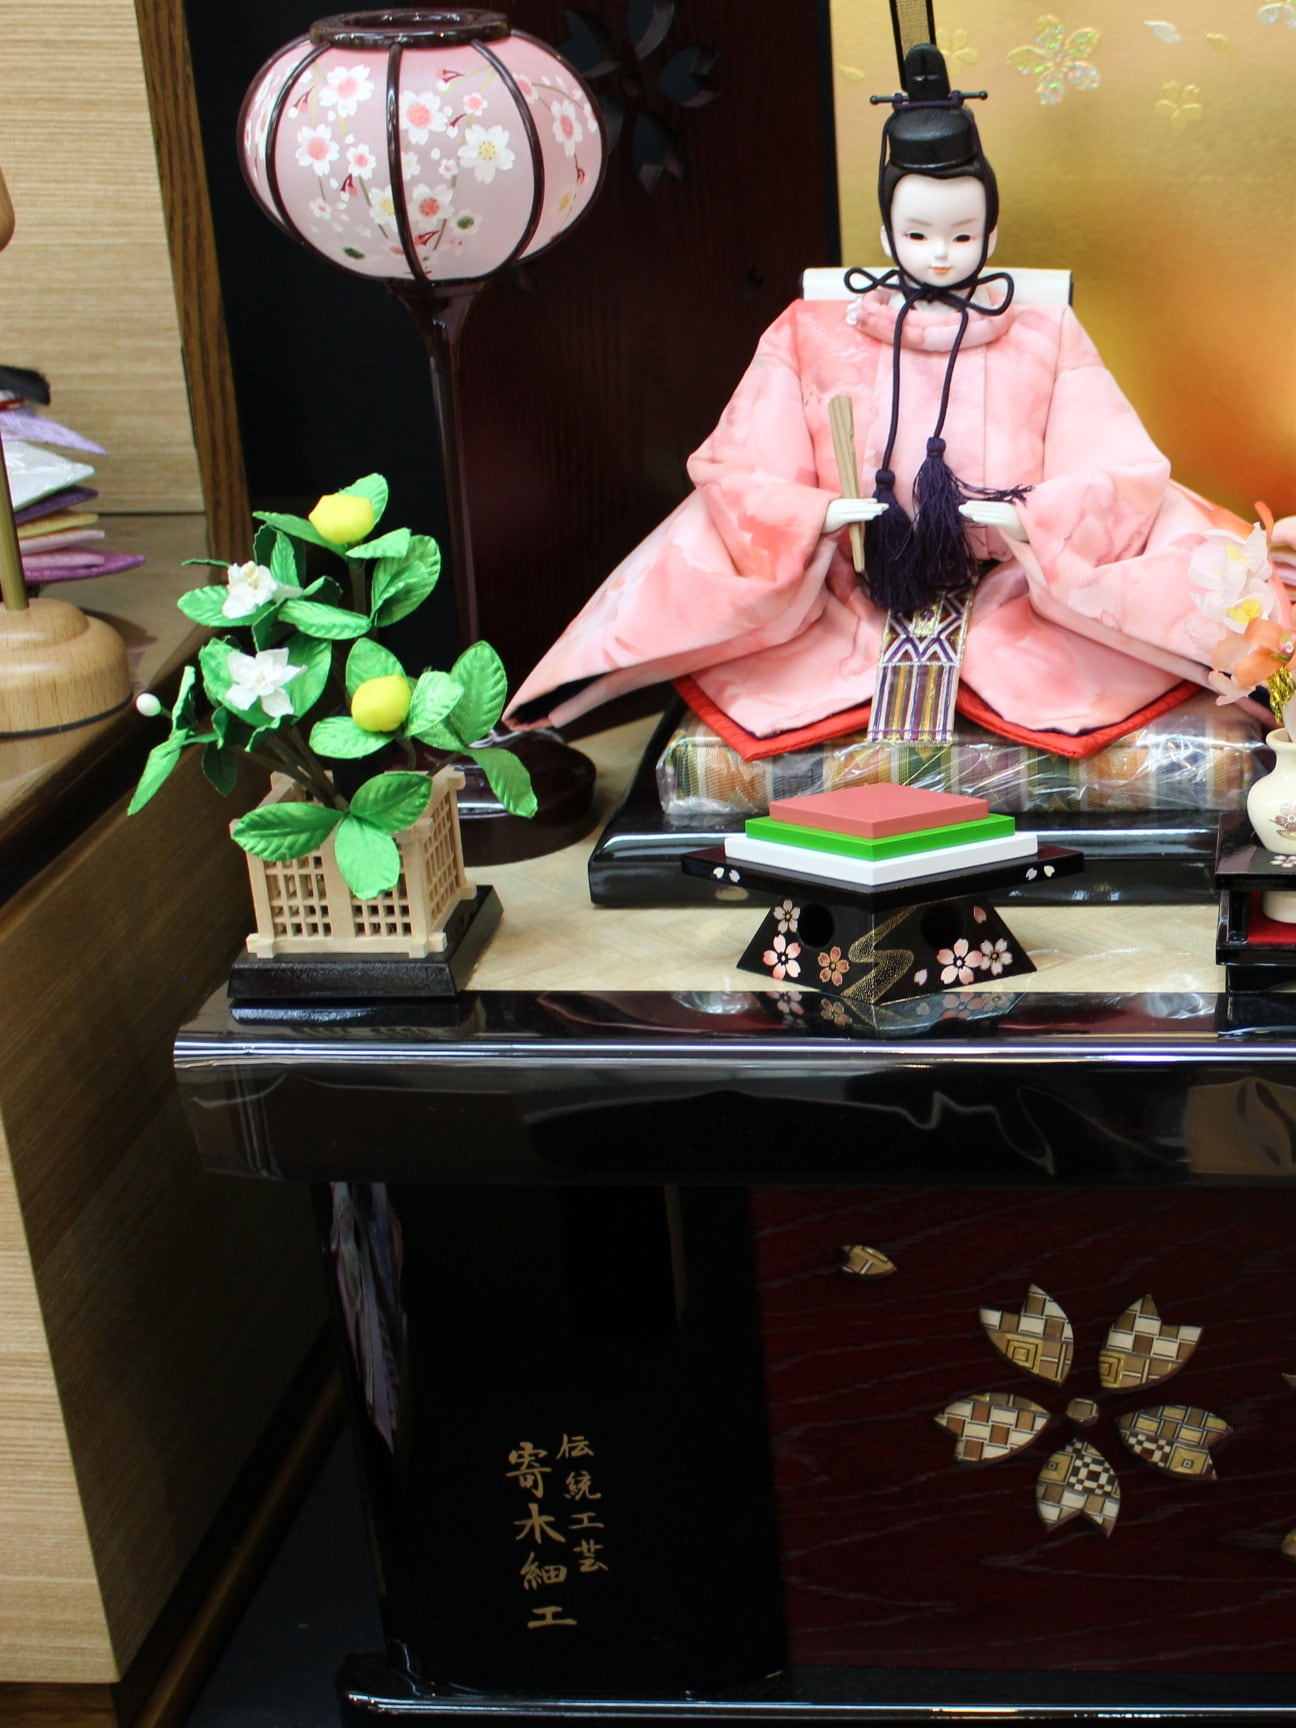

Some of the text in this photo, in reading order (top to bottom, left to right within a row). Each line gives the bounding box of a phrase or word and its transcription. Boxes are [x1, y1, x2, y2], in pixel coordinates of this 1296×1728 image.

[505, 1441, 577, 1629] 寄木細工
[556, 1433, 608, 1573] 伝統工芸
